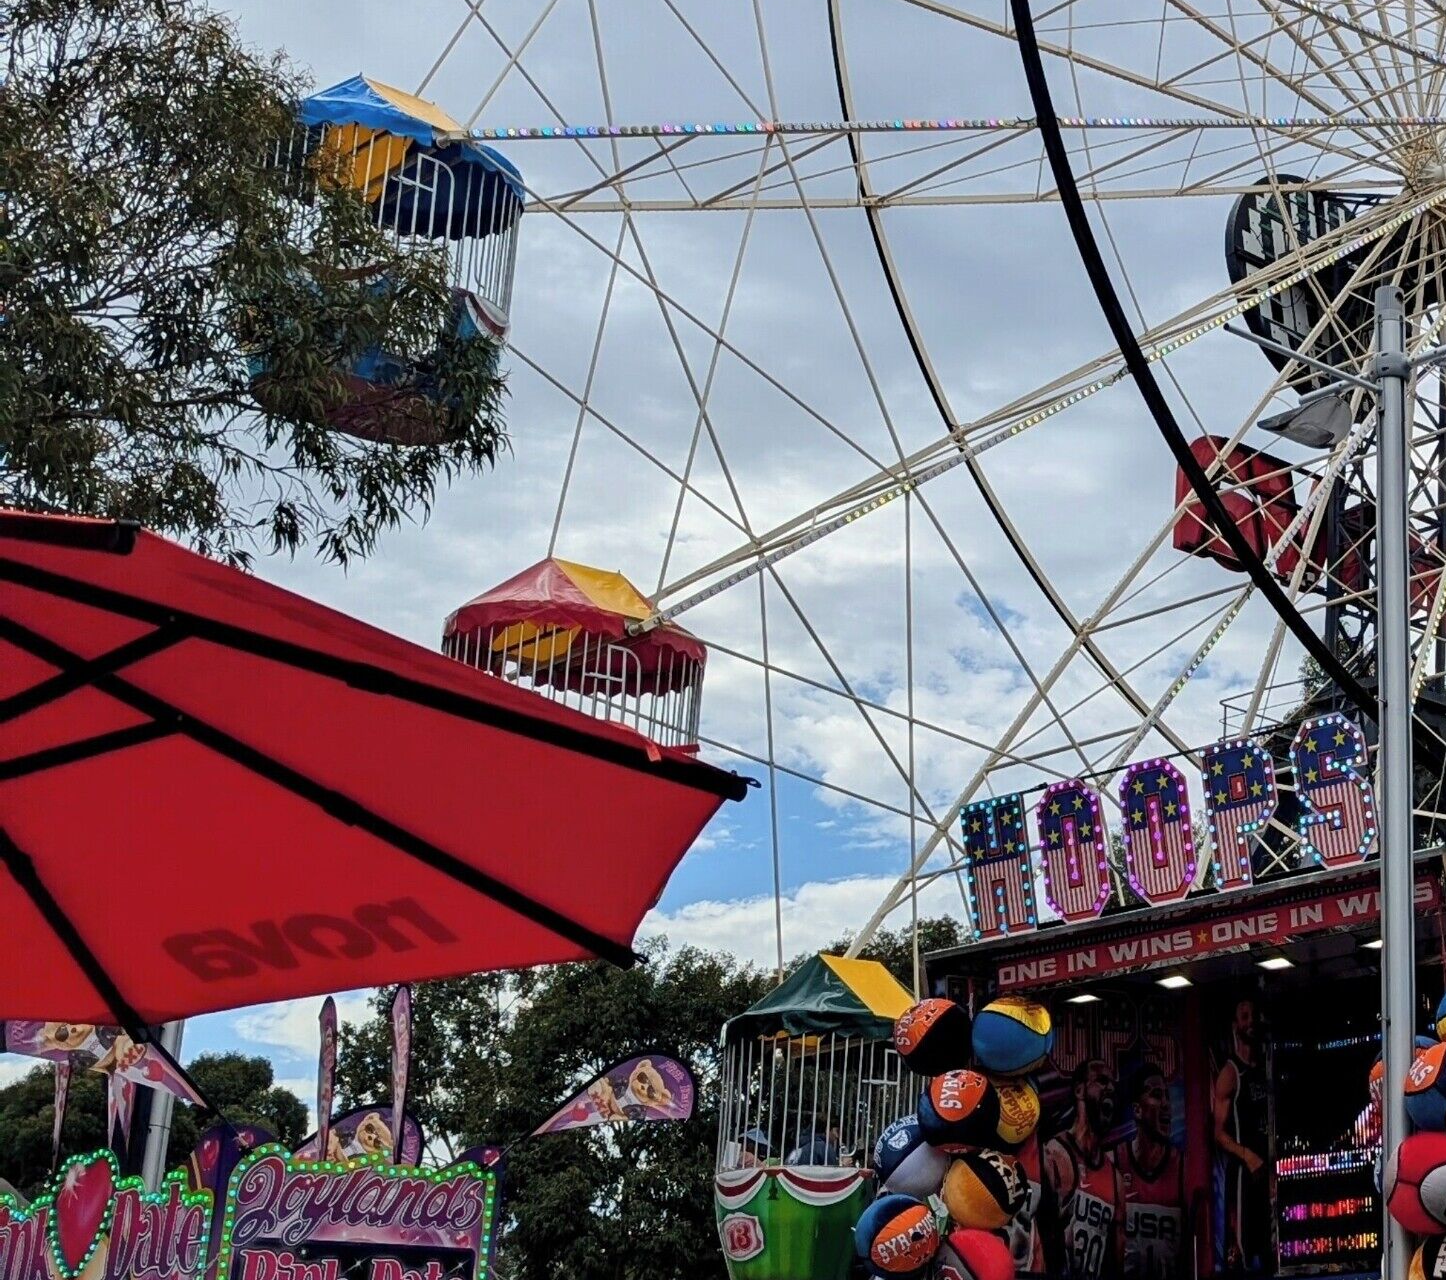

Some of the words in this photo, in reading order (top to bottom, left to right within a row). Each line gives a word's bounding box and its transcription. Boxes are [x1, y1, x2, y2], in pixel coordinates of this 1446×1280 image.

[960, 711, 1378, 941] HOOPS
[999, 960, 1057, 986] ONE
[1067, 949, 1097, 973] IN
[1109, 929, 1194, 967] WINS
[1211, 912, 1278, 944] ONE
[1290, 903, 1324, 928] IN
[229, 1155, 484, 1247] Joylands
[1075, 1194, 1113, 1228] USA
[1074, 1228, 1103, 1274] 30
